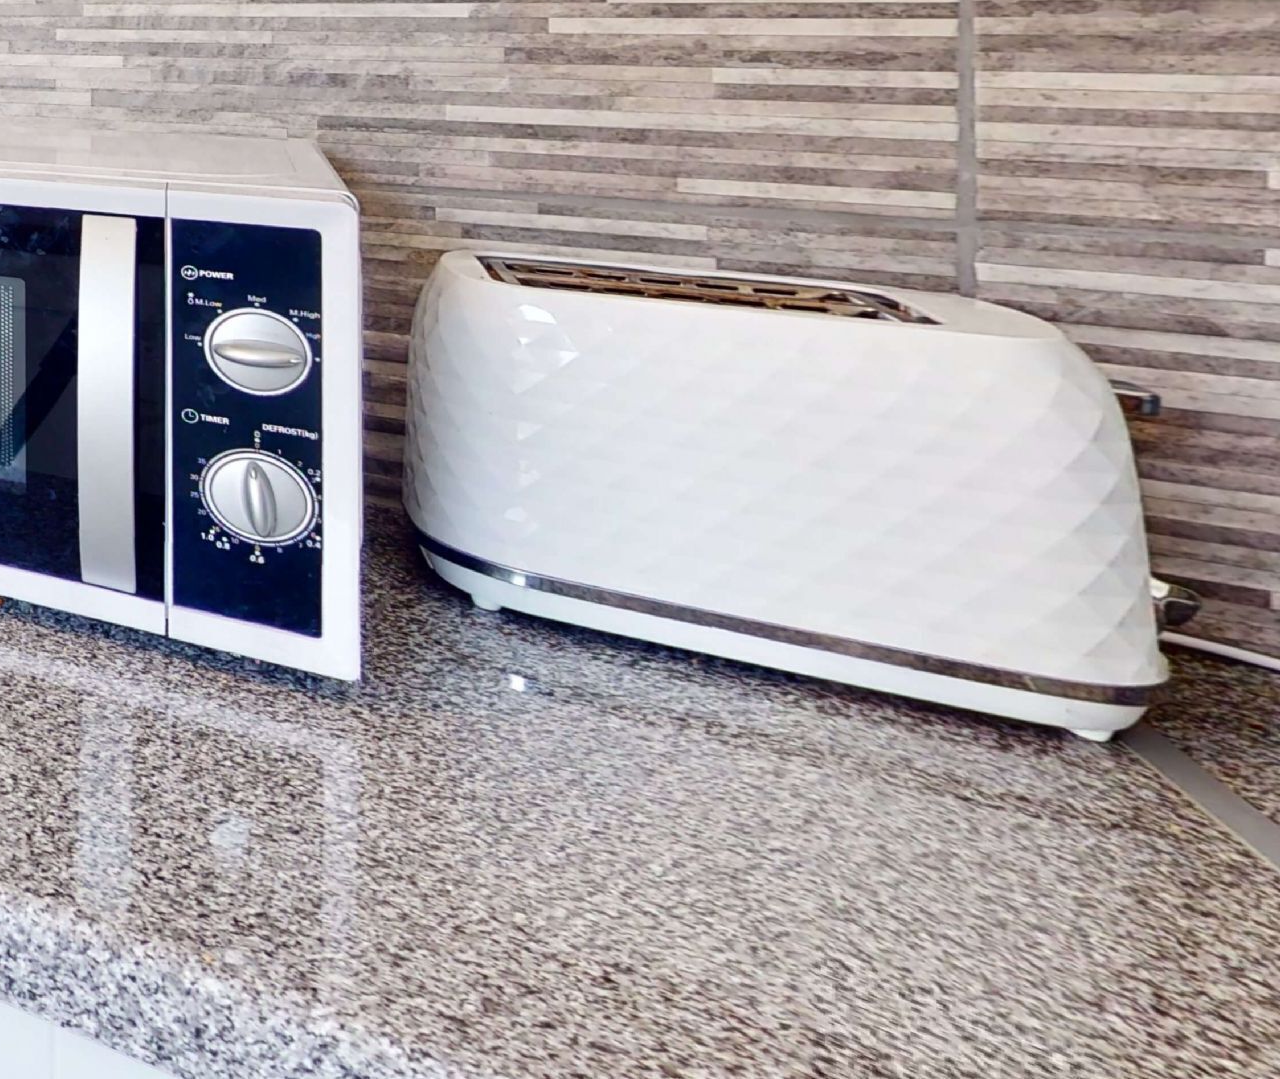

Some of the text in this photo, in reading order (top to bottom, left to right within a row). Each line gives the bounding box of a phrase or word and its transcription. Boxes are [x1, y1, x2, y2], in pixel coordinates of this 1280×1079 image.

[199, 270, 234, 280] POWER
[194, 298, 223, 308] M.Low
[247, 294, 267, 304] Med
[289, 309, 321, 319] M.High
[184, 333, 202, 341] Low
[200, 414, 230, 425] TIMER
